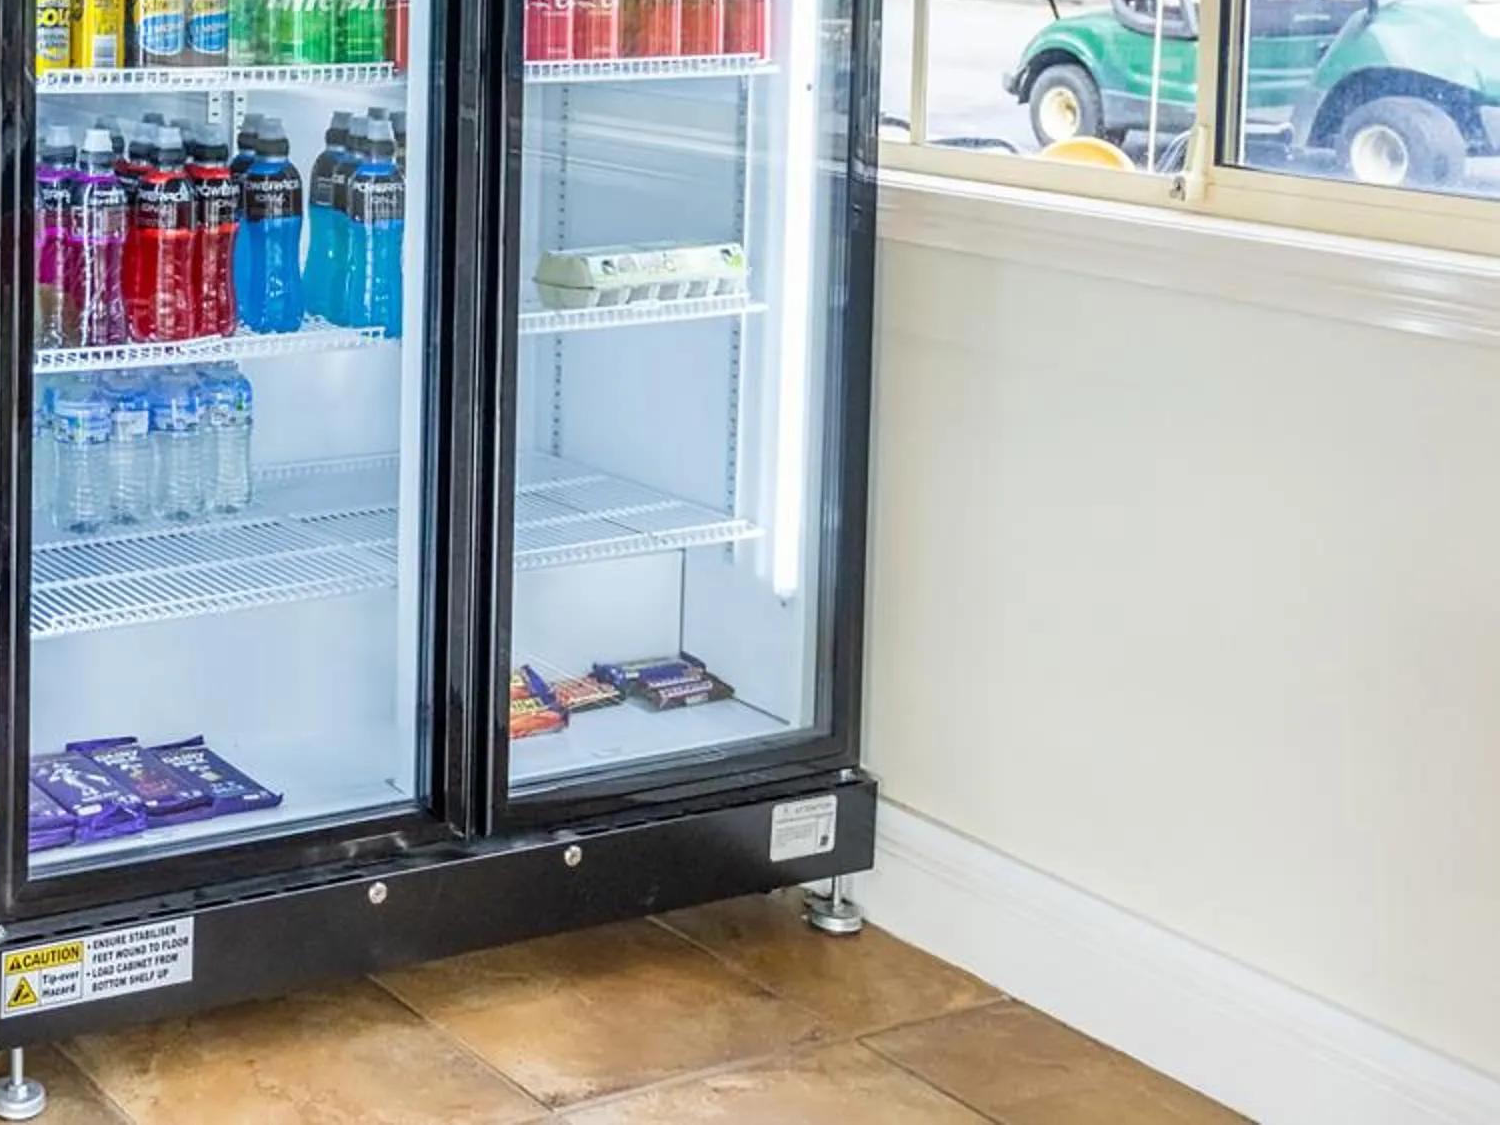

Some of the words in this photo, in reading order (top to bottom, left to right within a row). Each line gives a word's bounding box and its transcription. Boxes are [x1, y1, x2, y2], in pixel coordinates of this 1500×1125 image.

[93, 932, 127, 950] ENSURE
[129, 925, 177, 944] STABILISER
[93, 951, 113, 964] FEET
[149, 941, 160, 953] TO
[162, 935, 189, 950] FLOOR
[22, 945, 80, 968] CAUTION
[92, 966, 114, 979] LOAD
[154, 953, 179, 966] FROM
[43, 970, 79, 985] Tip-over
[92, 977, 127, 993] BOTTOM
[129, 972, 155, 985] SHELF
[156, 967, 169, 978] UP
